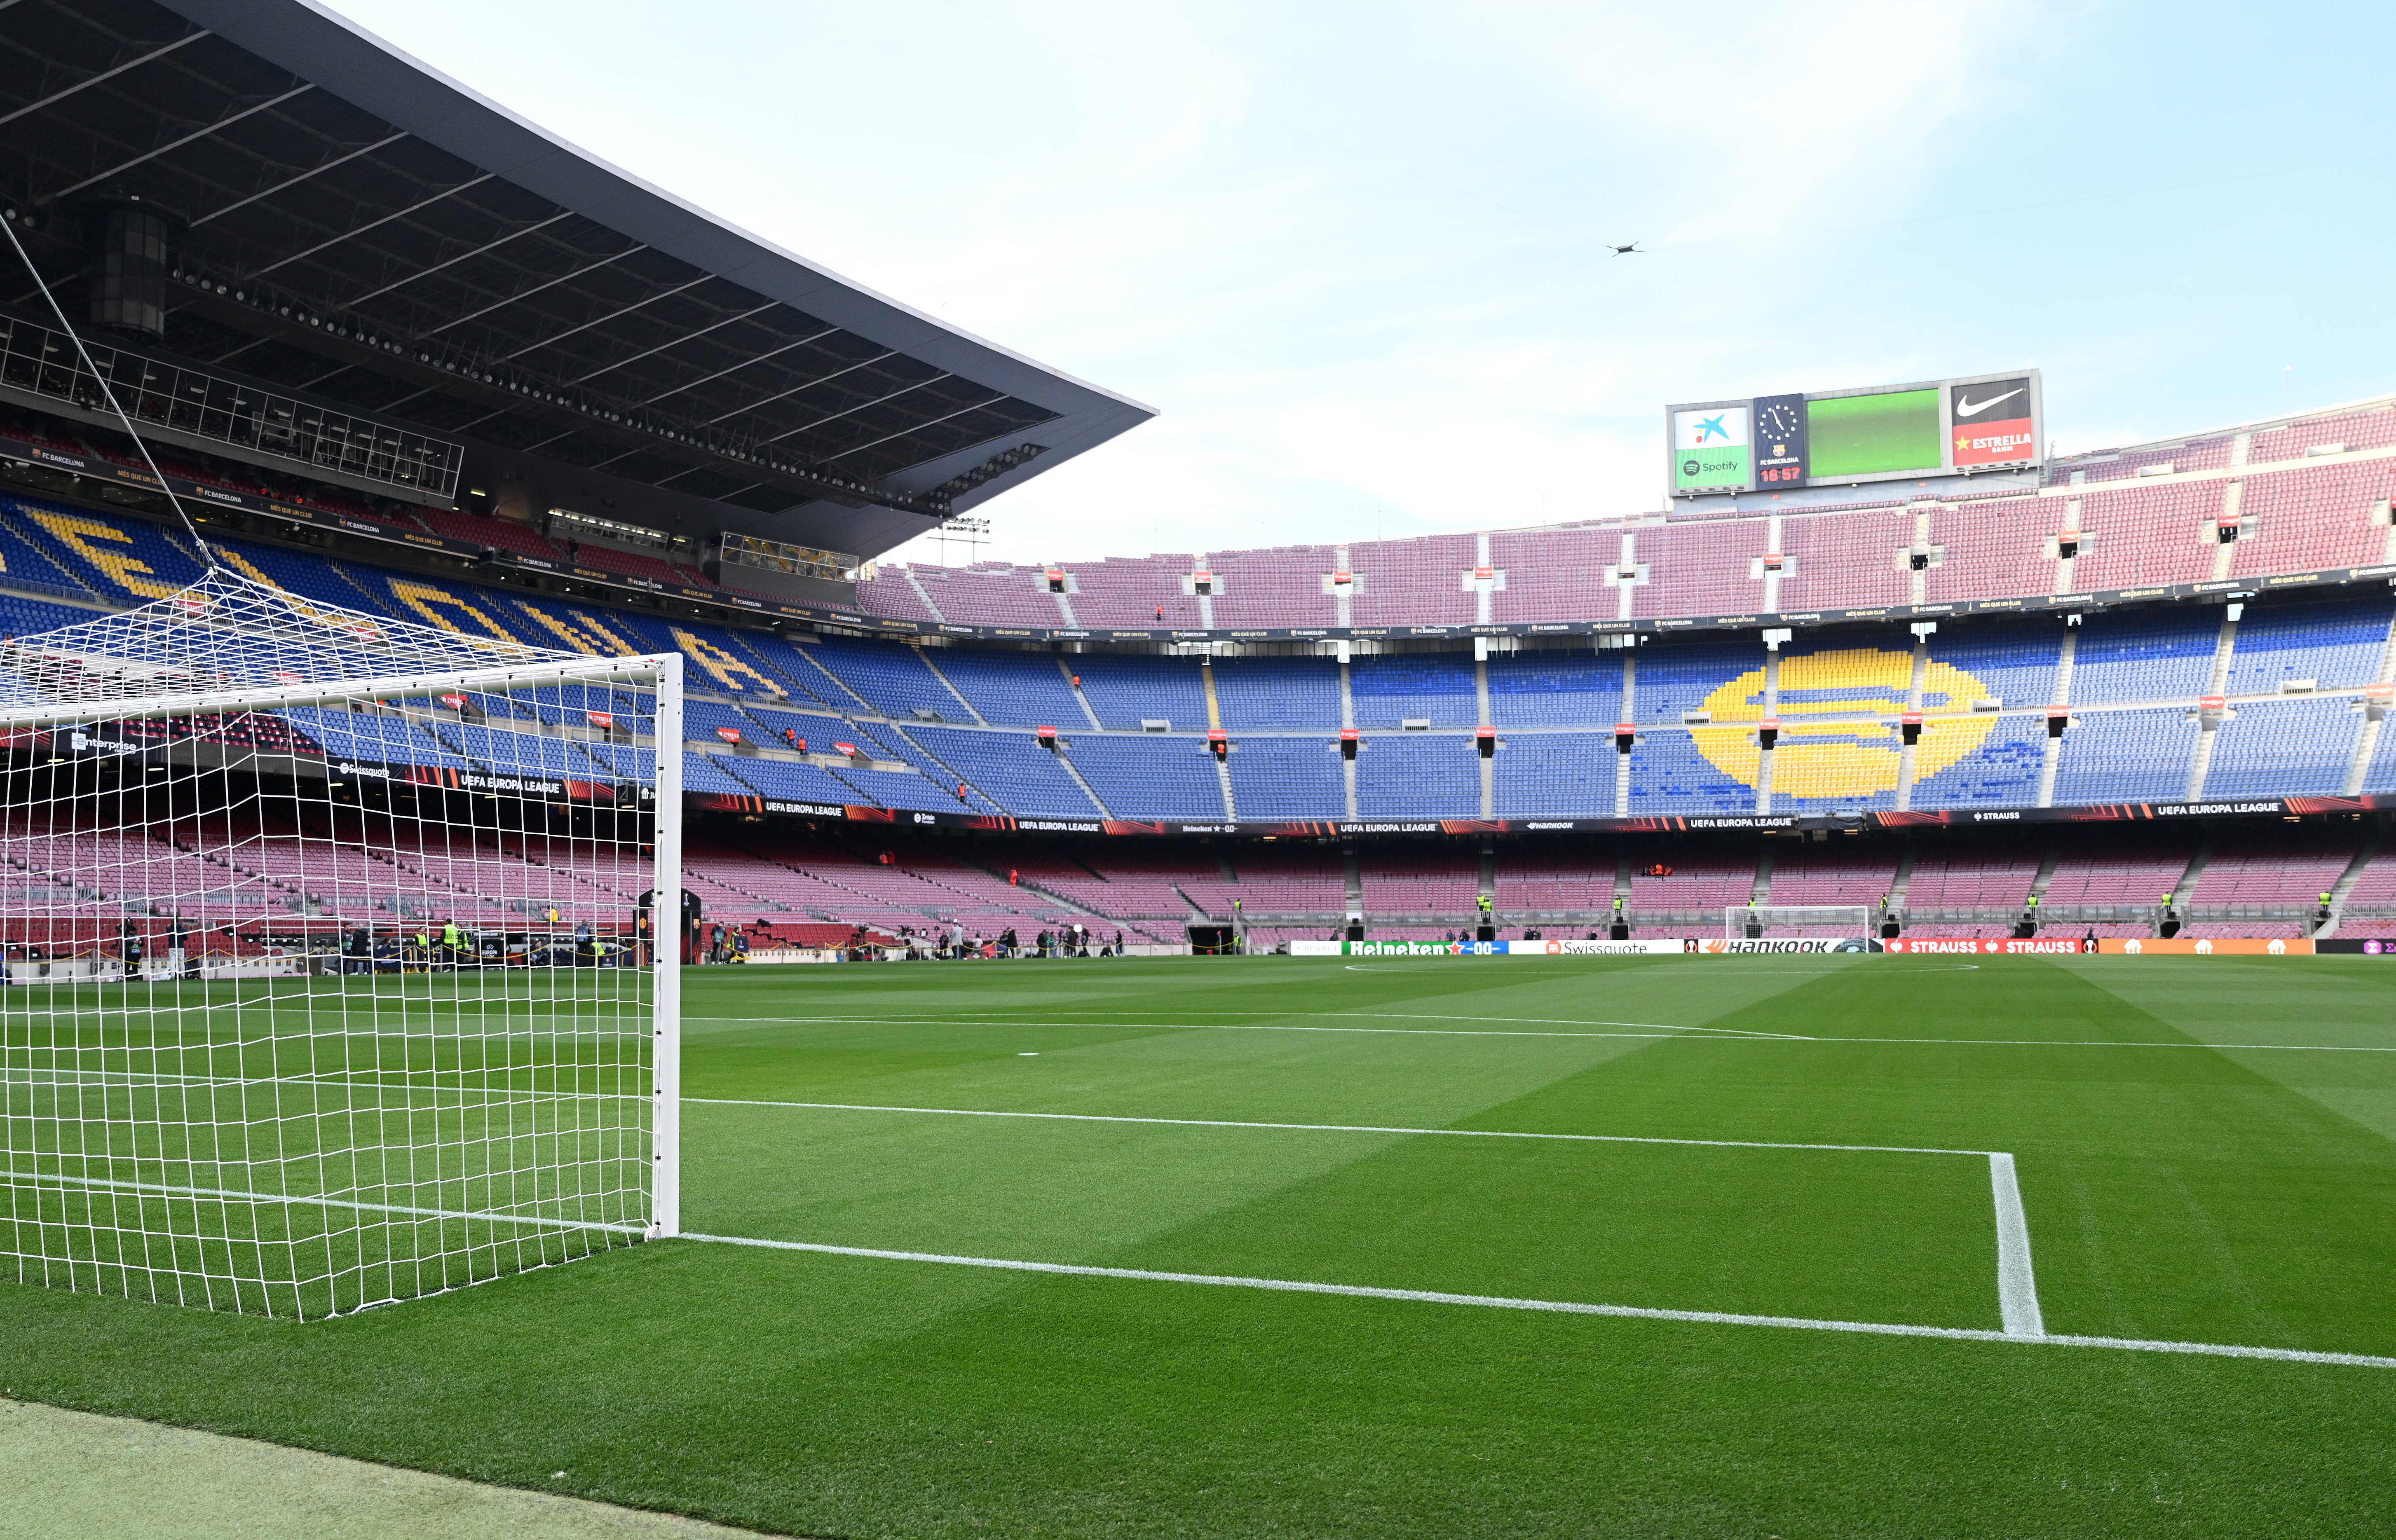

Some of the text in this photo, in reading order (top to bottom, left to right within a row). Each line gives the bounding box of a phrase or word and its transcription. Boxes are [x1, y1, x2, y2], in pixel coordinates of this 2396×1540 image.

[1973, 433, 2031, 449] ESTRELLA
[50, 454, 84, 468] BARCELONA
[1703, 461, 1737, 472] Spotify
[213, 491, 241, 503] BARCELONA
[354, 523, 379, 533] BARCELONA
[529, 559, 551, 568] BARCELONA
[77, 737, 136, 750] enterprise
[349, 763, 389, 777] Swissquote
[461, 775, 485, 786] UEFA
[488, 777, 523, 791] EUROPA
[767, 802, 842, 816] UEFA EUROPA LEAGUE
[2158, 803, 2279, 815] UEFA EUROPA LEAGUE
[1020, 821, 1098, 831] UEFA EUROPA LEAGUE
[1690, 818, 1791, 827] UEFA EUROPA LEAGUE
[1350, 941, 1444, 955] Heineken
[1564, 942, 1647, 954] Swissquote
[1911, 941, 2075, 953] STRAUSS STRAUSS
